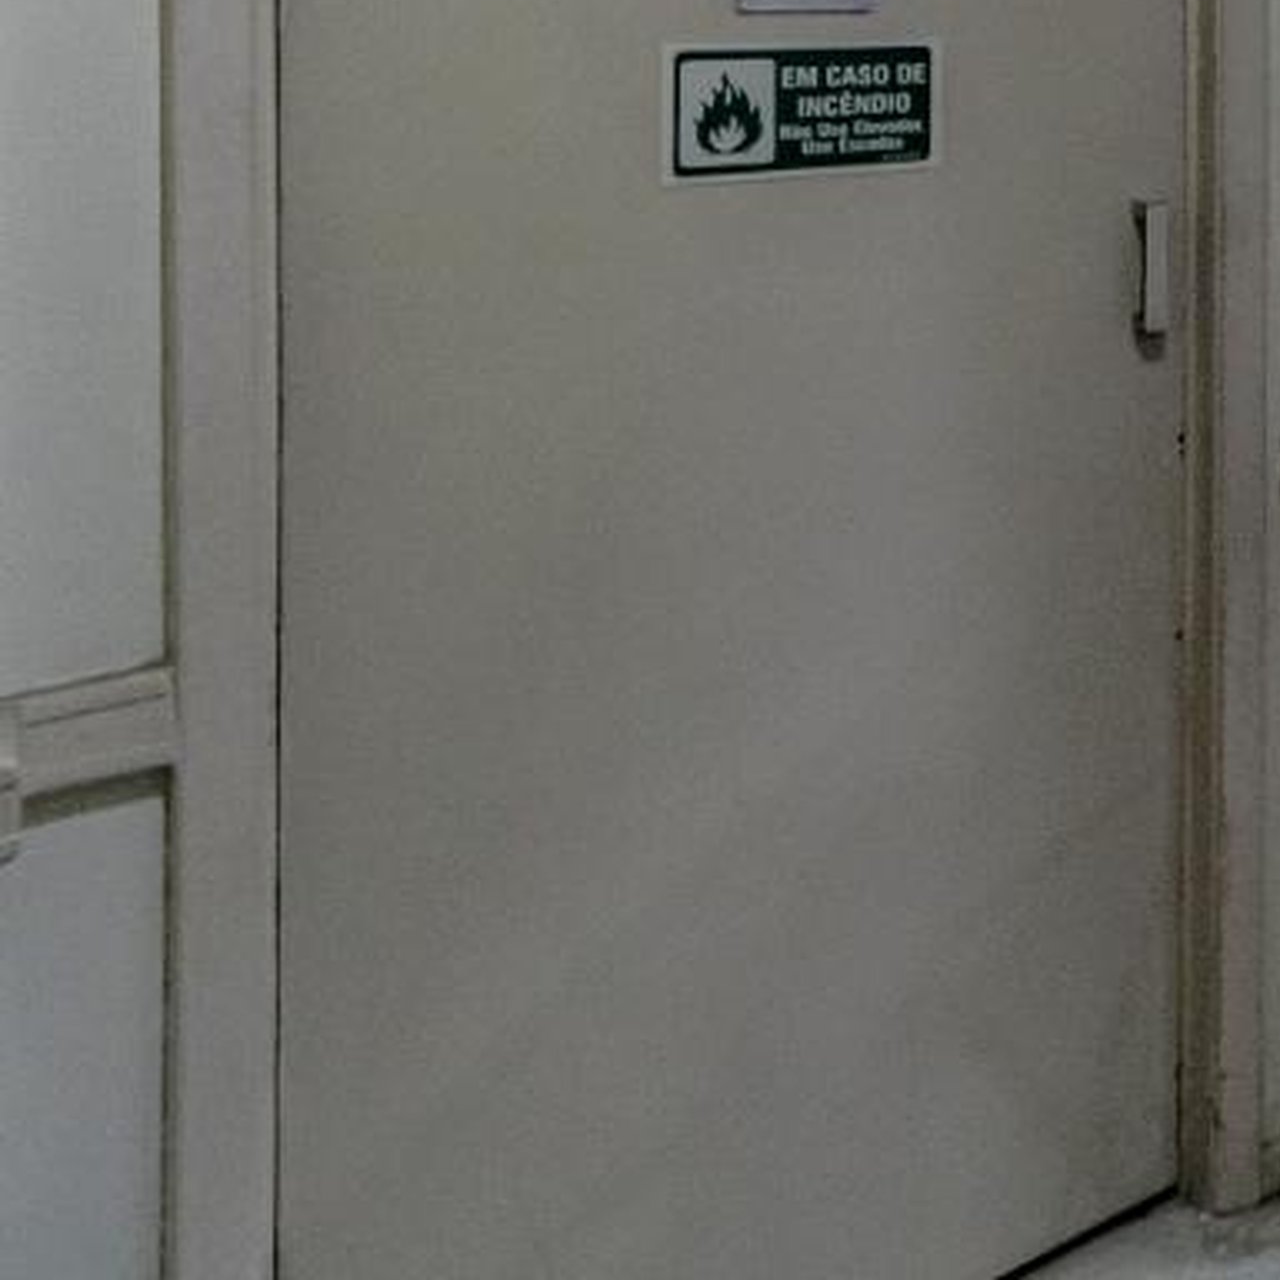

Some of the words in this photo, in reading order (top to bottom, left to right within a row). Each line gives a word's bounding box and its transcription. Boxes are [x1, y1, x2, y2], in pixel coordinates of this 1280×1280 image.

[781, 65, 818, 89] EM
[825, 63, 890, 87] CASO
[896, 62, 927, 85] DE
[798, 90, 912, 118] INCÊNDIO
